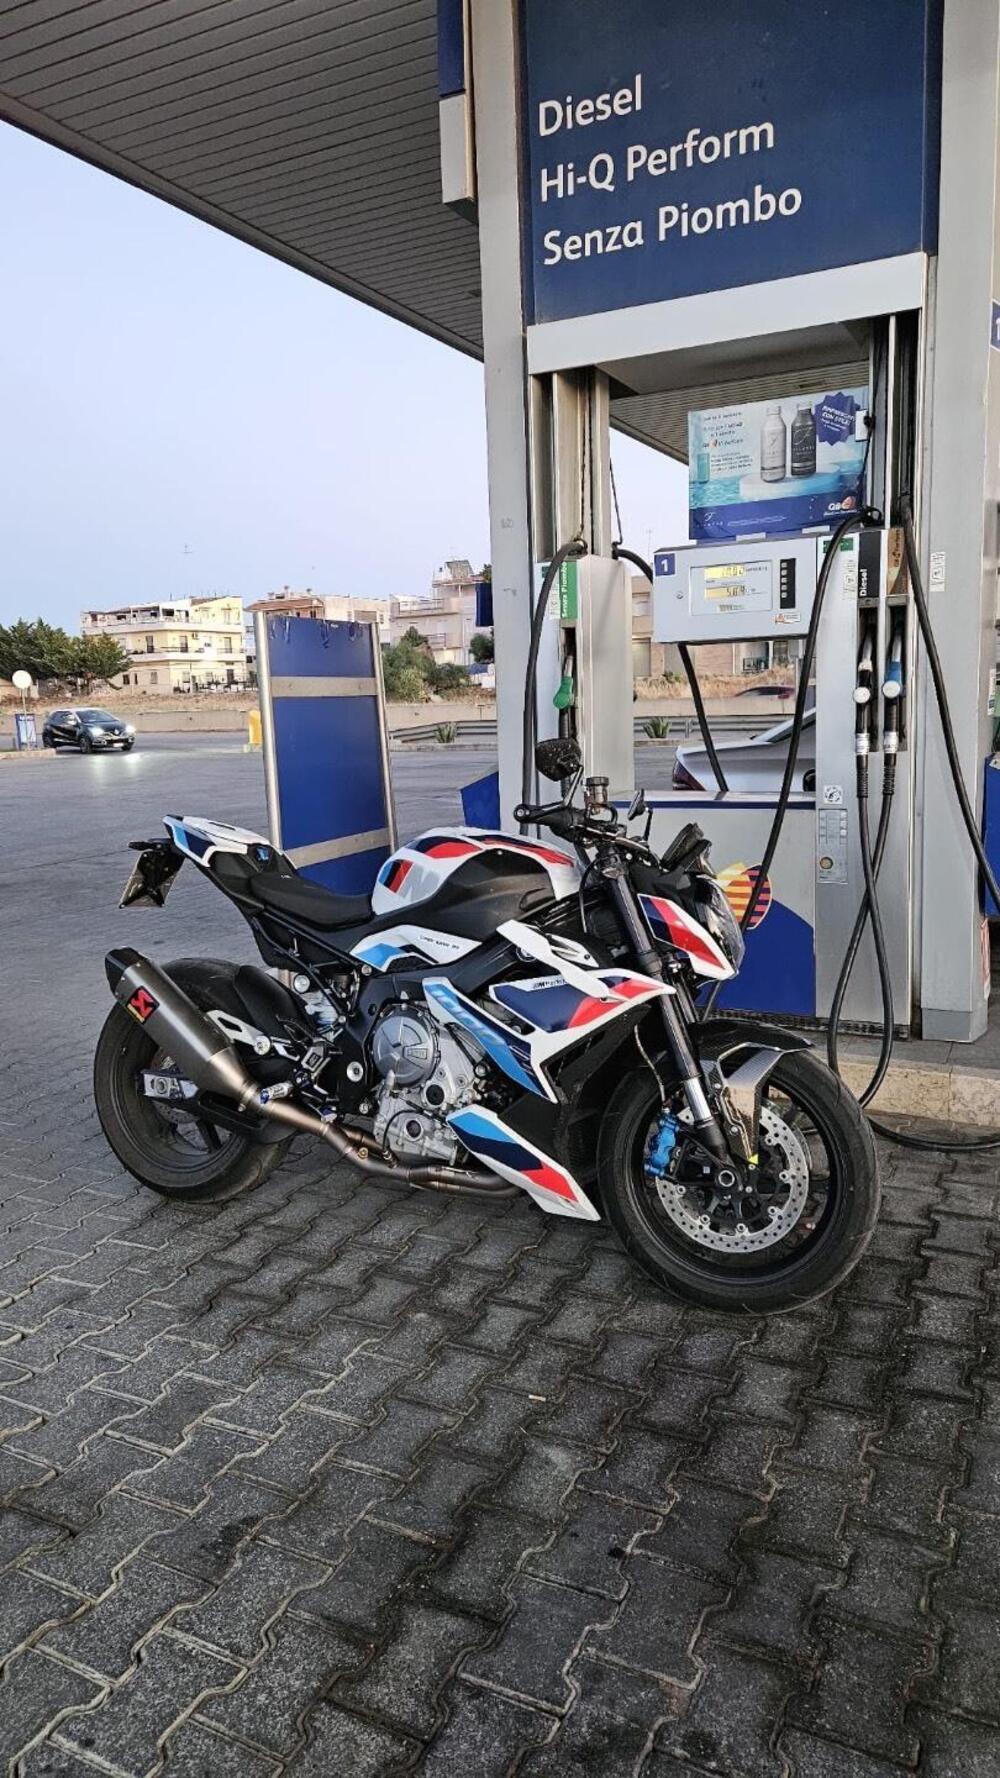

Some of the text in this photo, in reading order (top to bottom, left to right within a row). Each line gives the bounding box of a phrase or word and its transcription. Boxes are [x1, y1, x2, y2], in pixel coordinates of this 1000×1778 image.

[539, 73, 642, 137] Diesel
[541, 122, 774, 202] Hi-Q Perform
[543, 184, 802, 265] Senza Piombo
[661, 558, 668, 572] 1
[859, 568, 868, 597] Diesel
